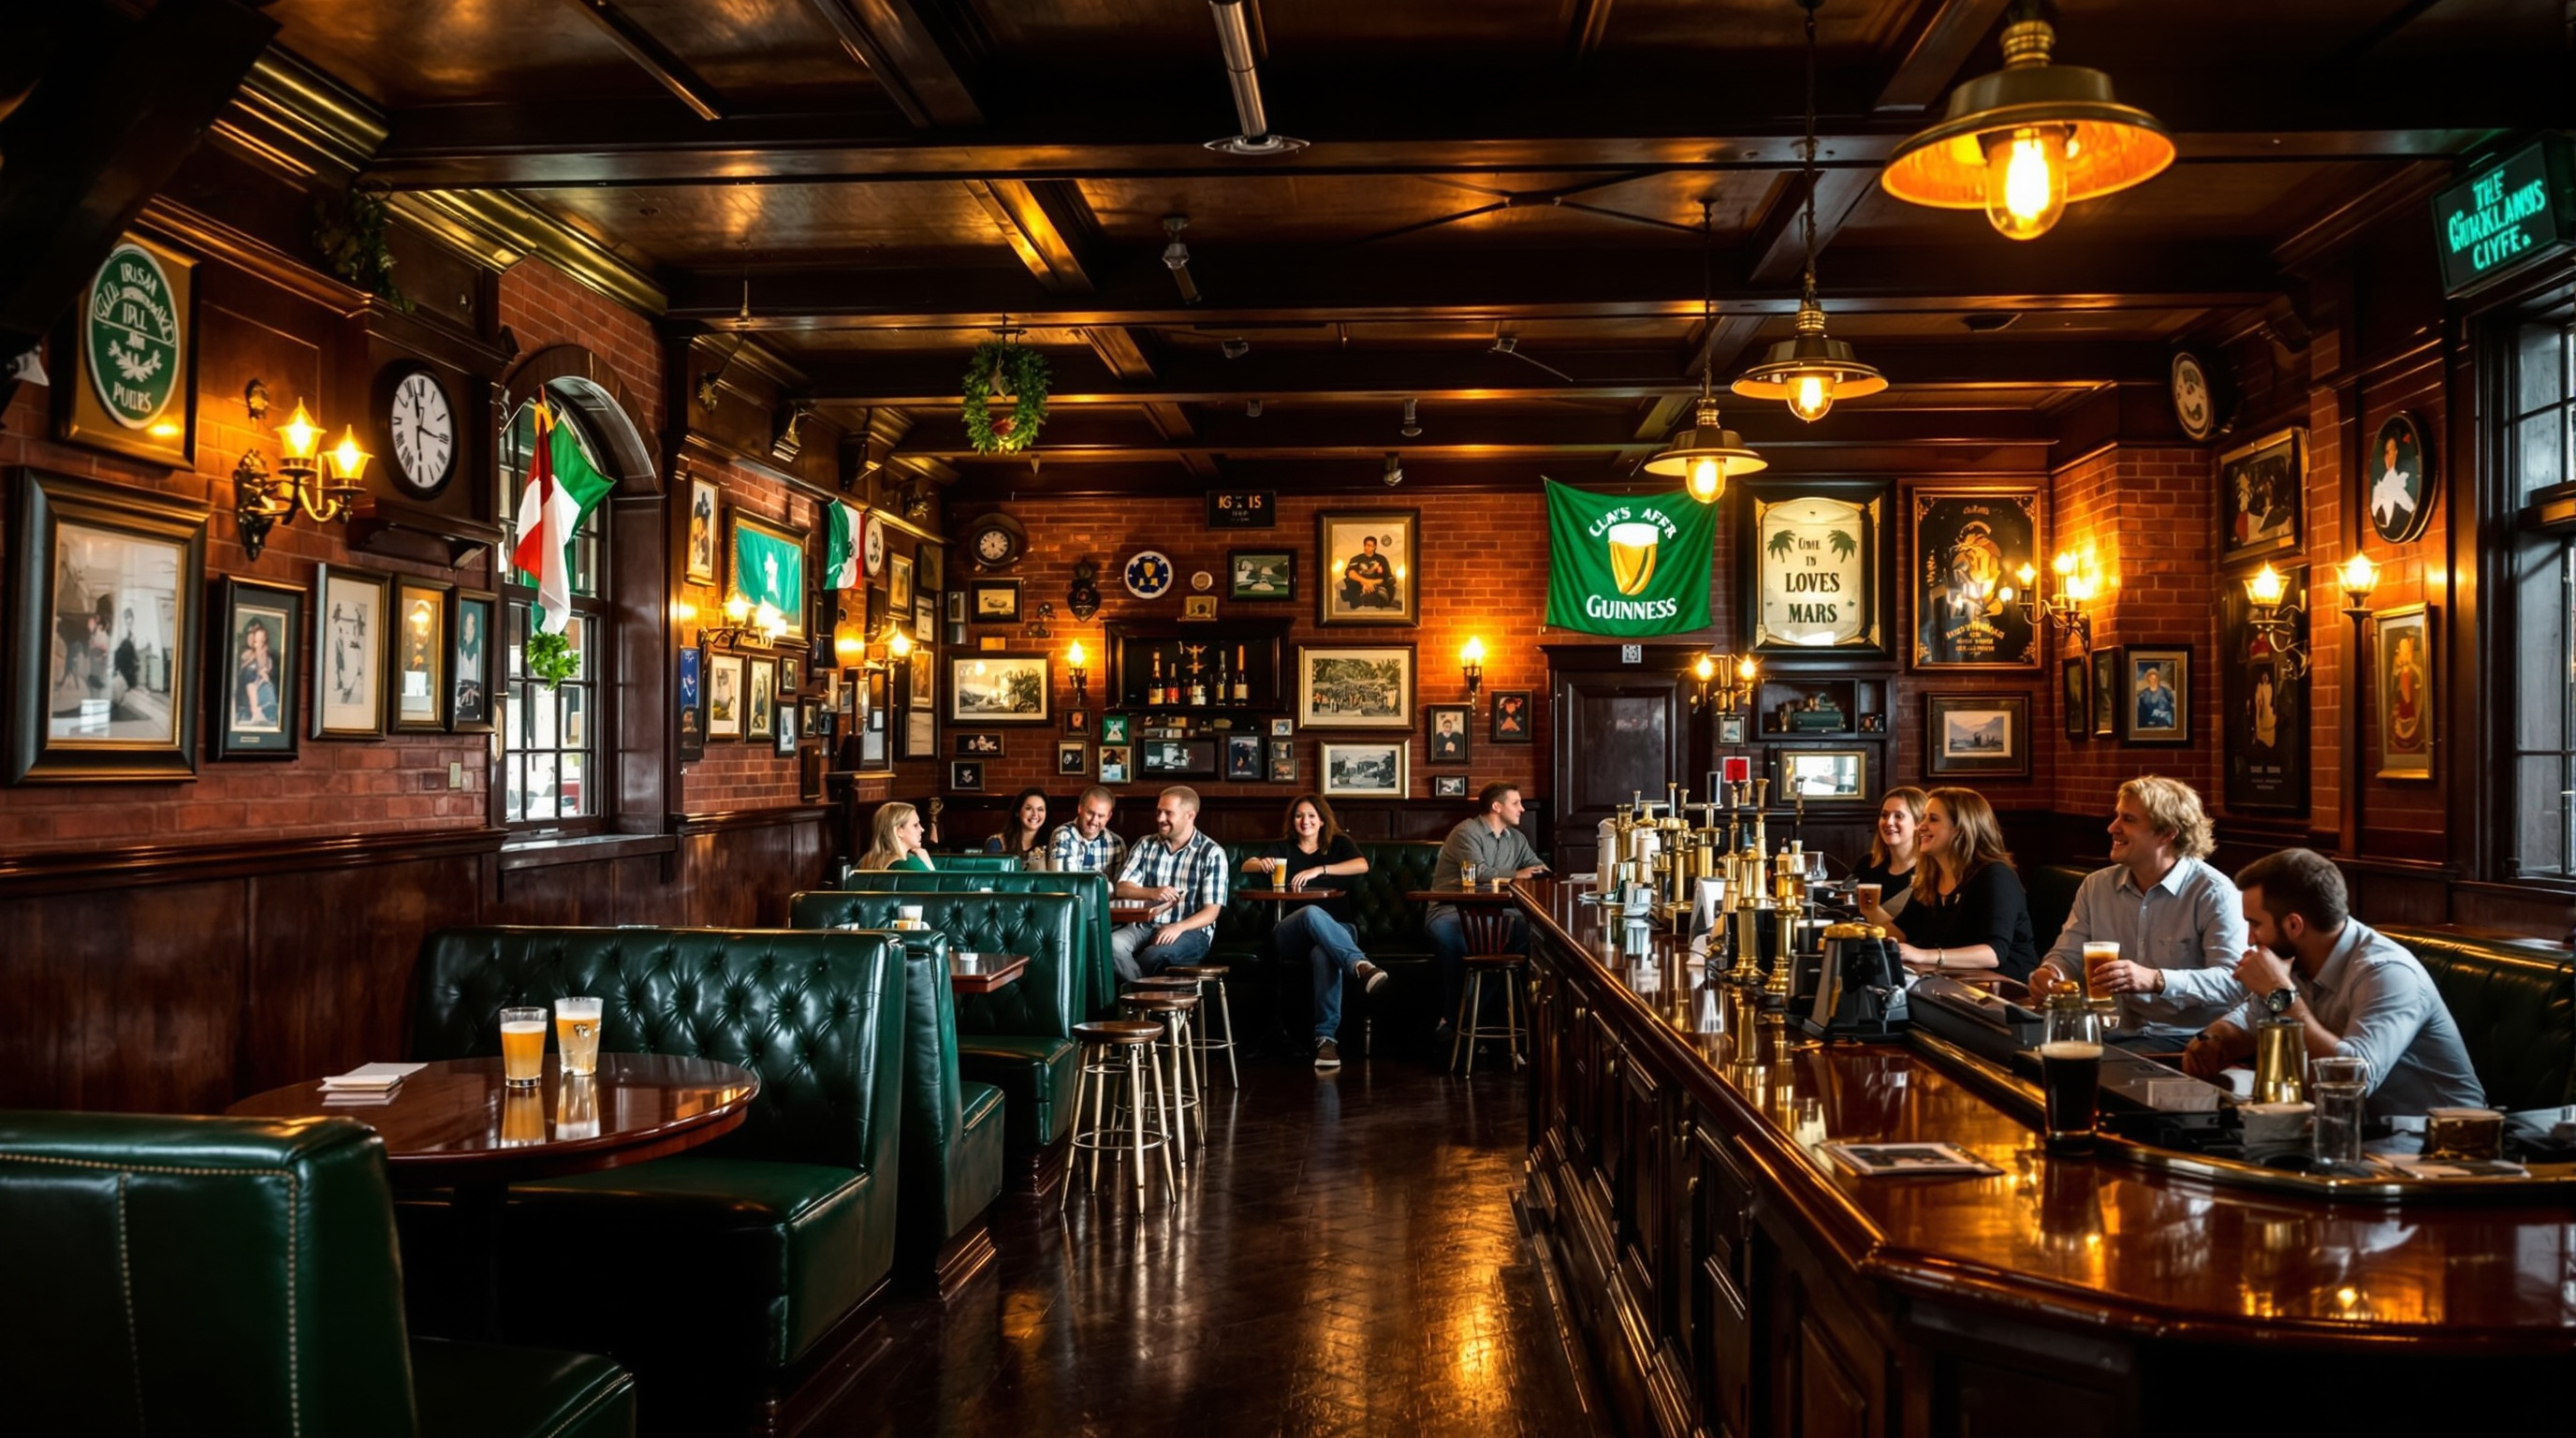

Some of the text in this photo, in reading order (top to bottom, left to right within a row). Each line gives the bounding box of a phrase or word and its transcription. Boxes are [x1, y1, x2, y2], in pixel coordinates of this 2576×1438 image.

[1785, 572, 1840, 593] LOVES
[1586, 594, 1677, 620] GUINNESS
[1788, 603, 1837, 624] MARS
